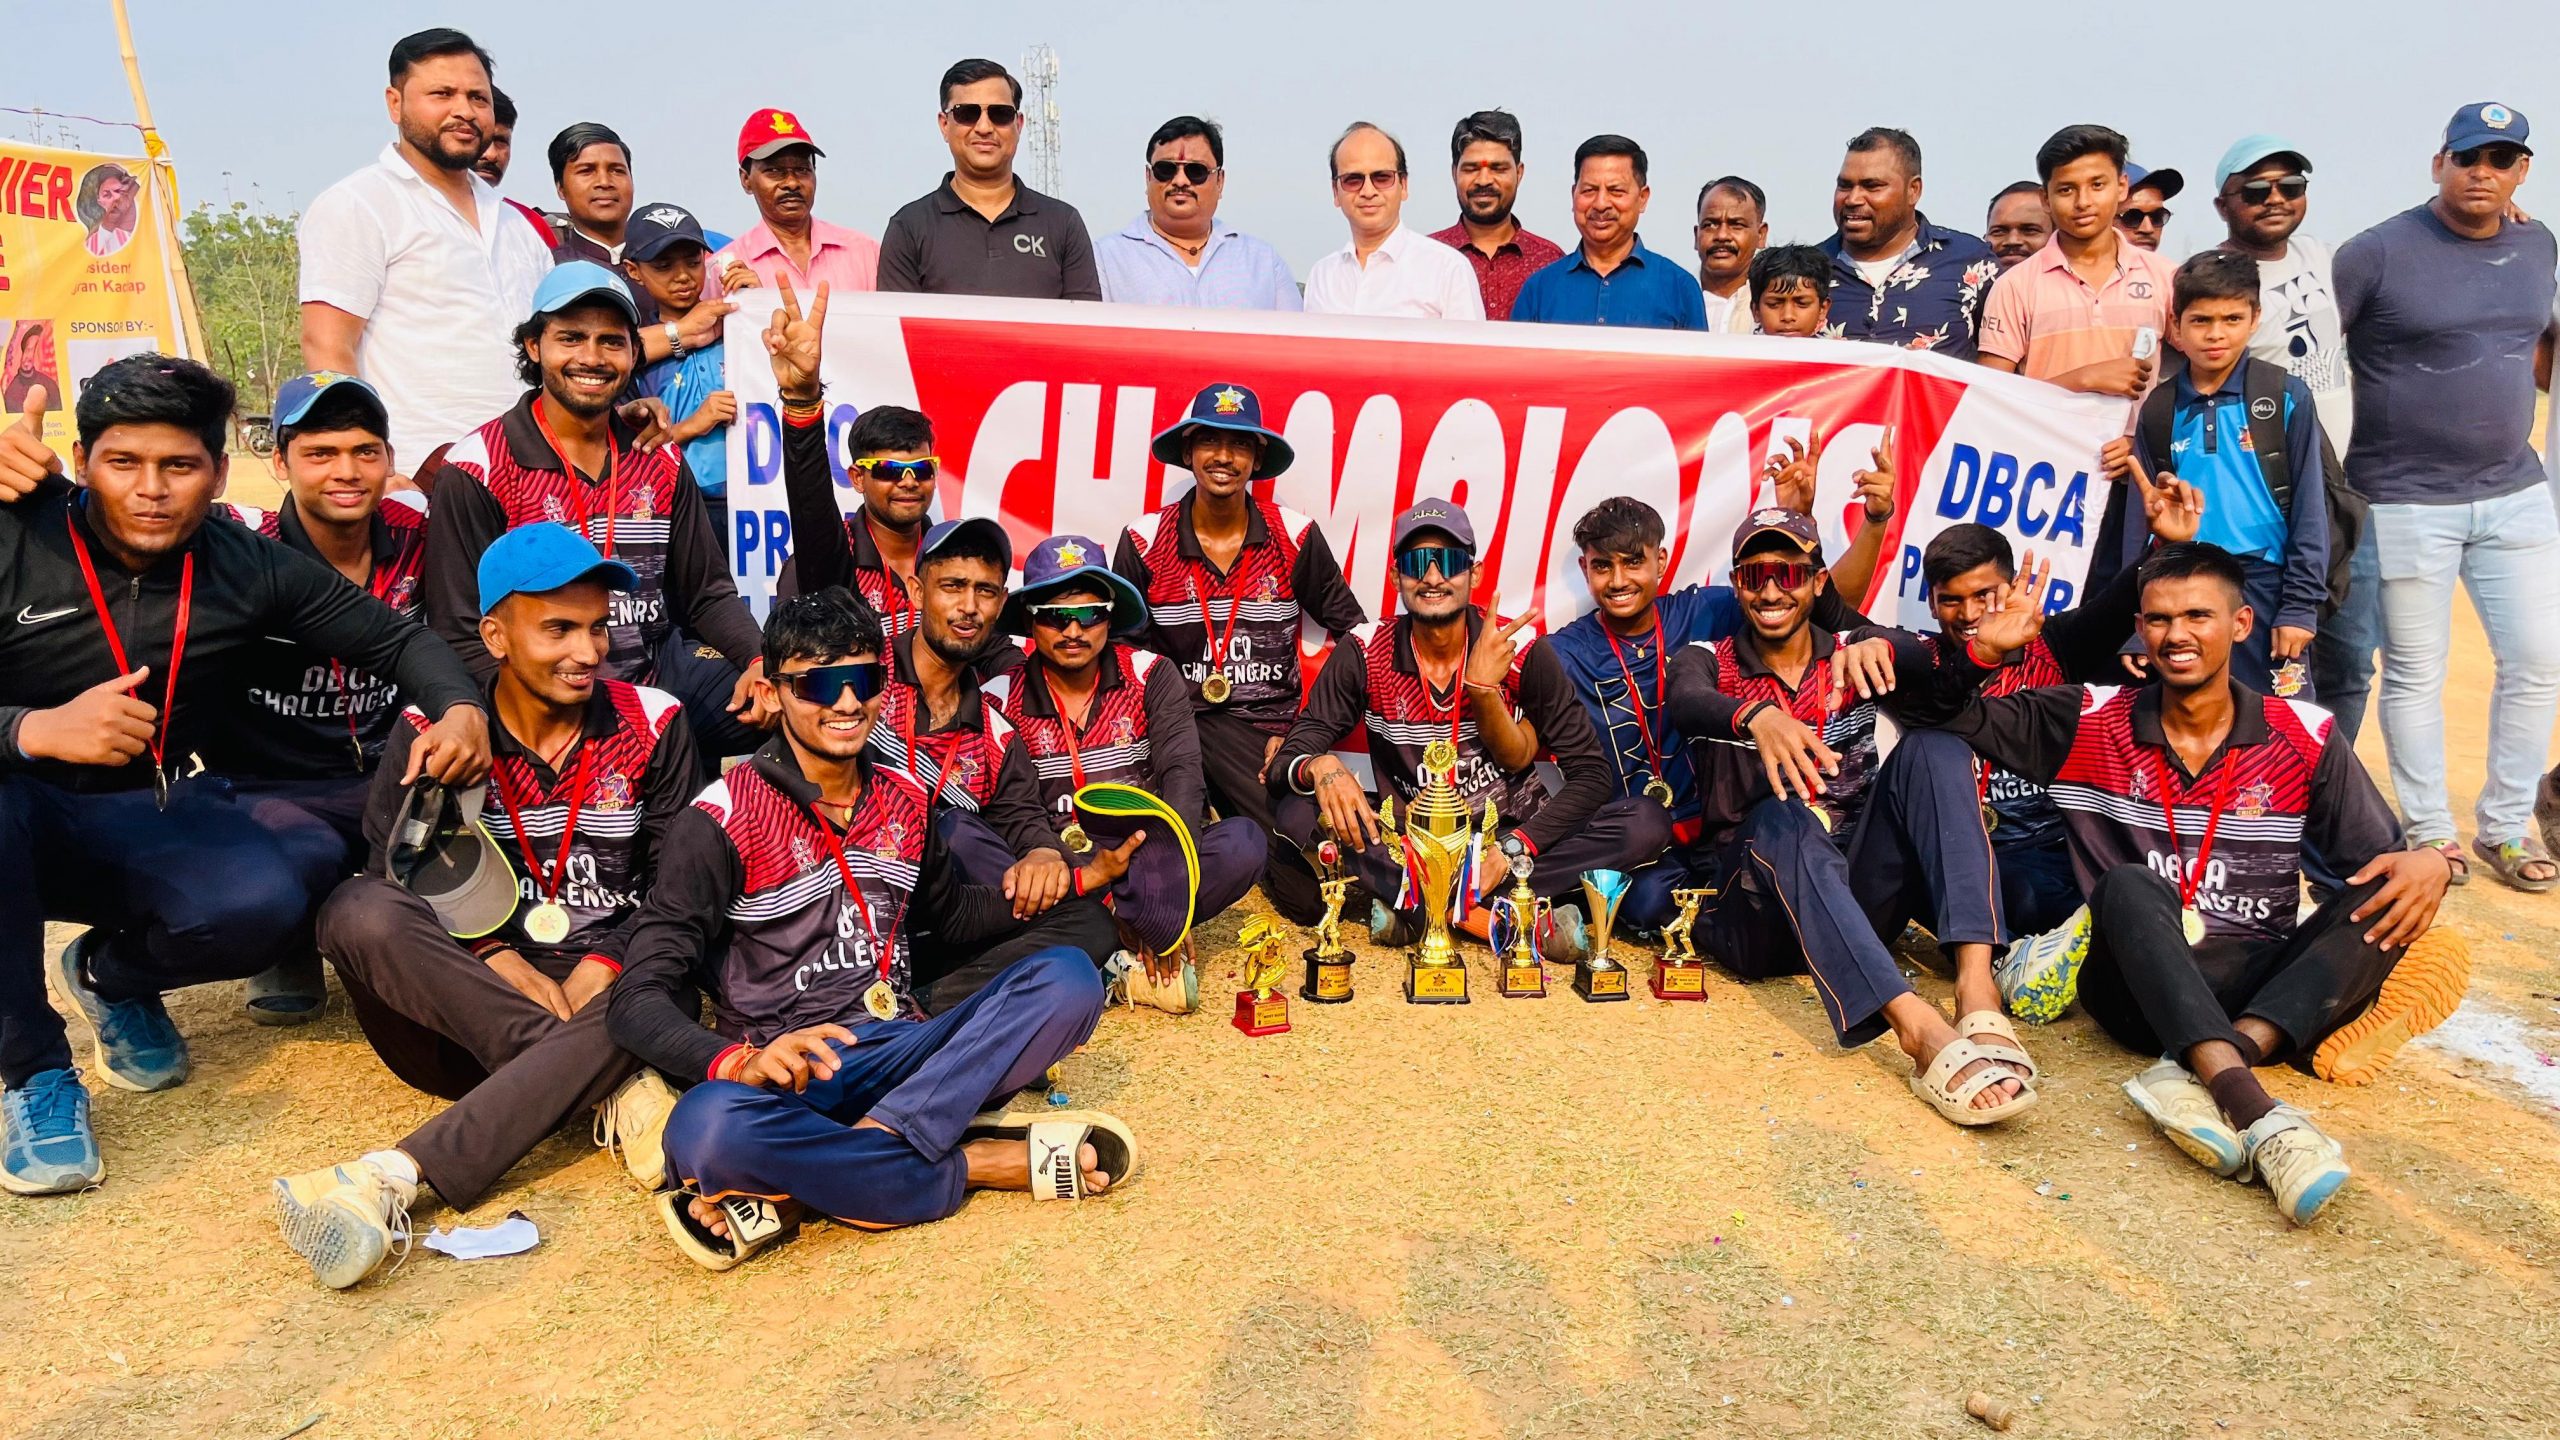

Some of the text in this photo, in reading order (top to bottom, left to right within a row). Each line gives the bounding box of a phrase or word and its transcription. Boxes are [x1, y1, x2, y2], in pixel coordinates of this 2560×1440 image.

[1013, 233, 1047, 258] CK
[960, 381, 1896, 658] CHMPIONS
[1936, 442, 2089, 548] DBCA
[1055, 1155, 1075, 1199] PUMA
